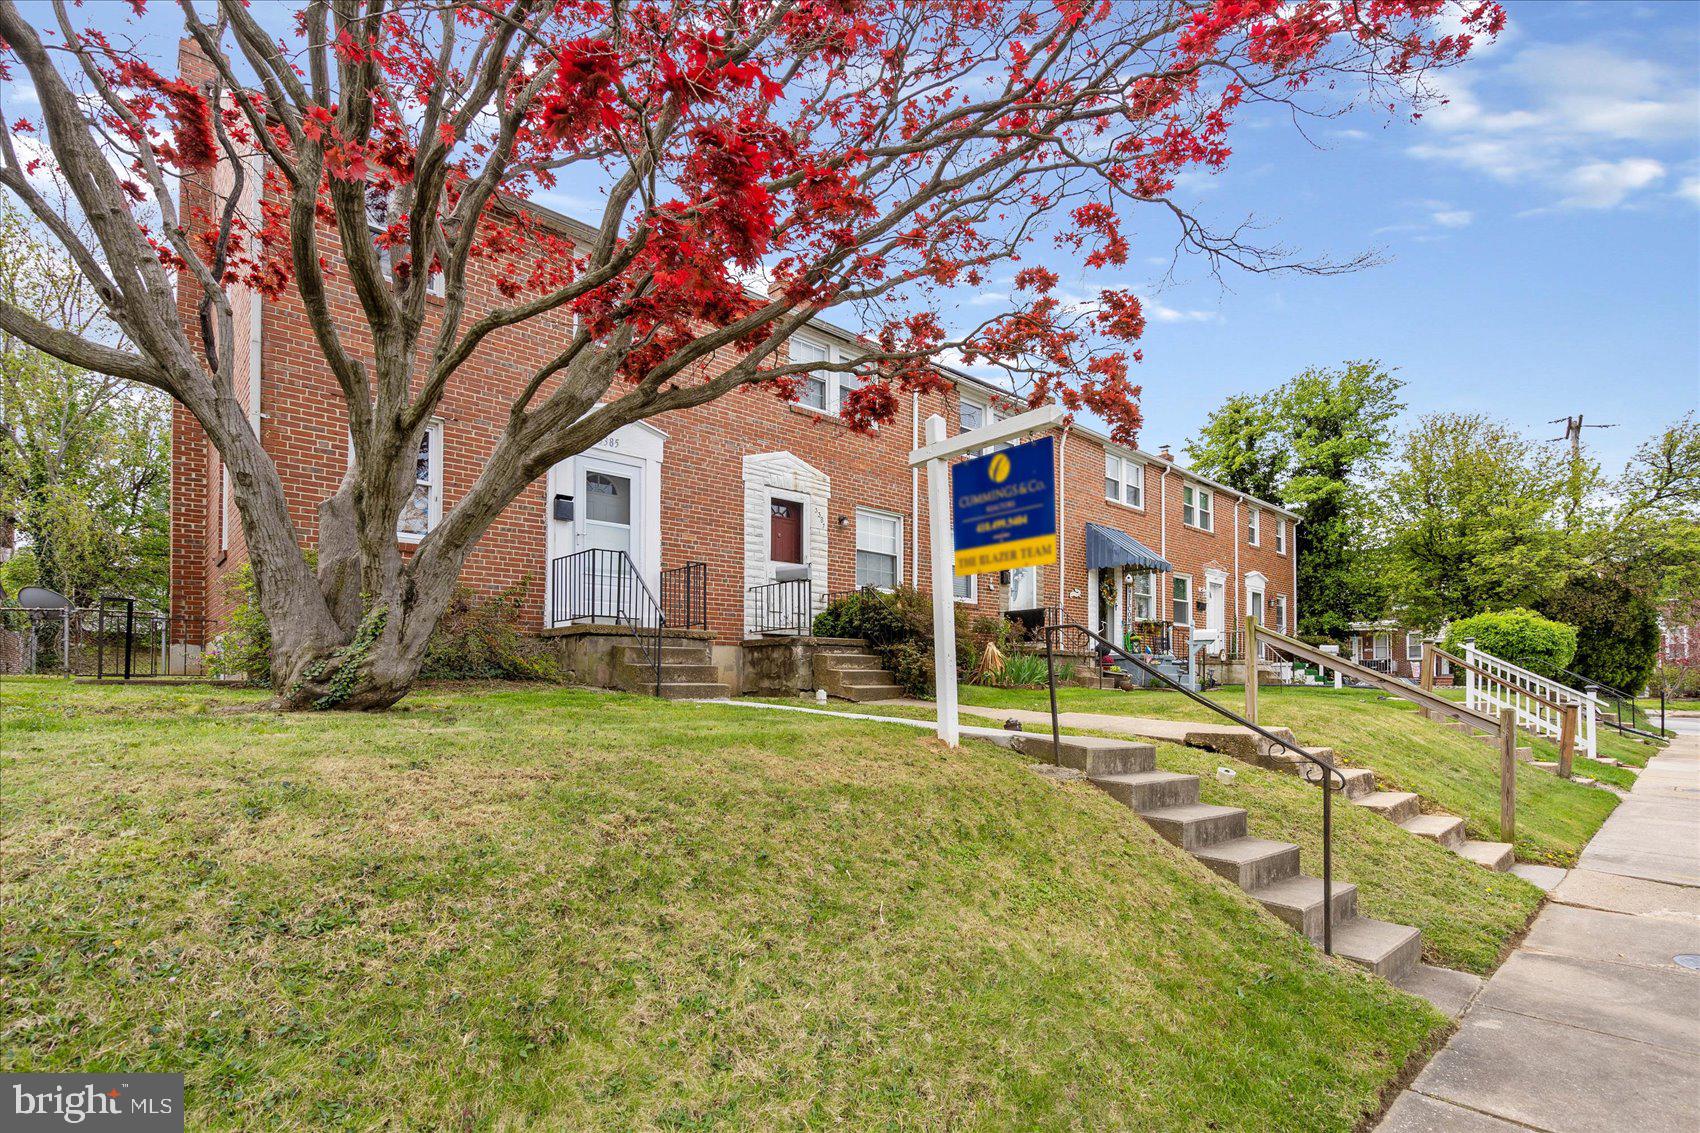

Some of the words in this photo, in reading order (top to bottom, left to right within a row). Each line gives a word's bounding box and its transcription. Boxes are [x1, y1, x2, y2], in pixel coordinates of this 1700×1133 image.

[958, 557, 976, 568] THE
[979, 549, 1017, 565] BLAZER
[1020, 544, 1052, 559] TEAM
